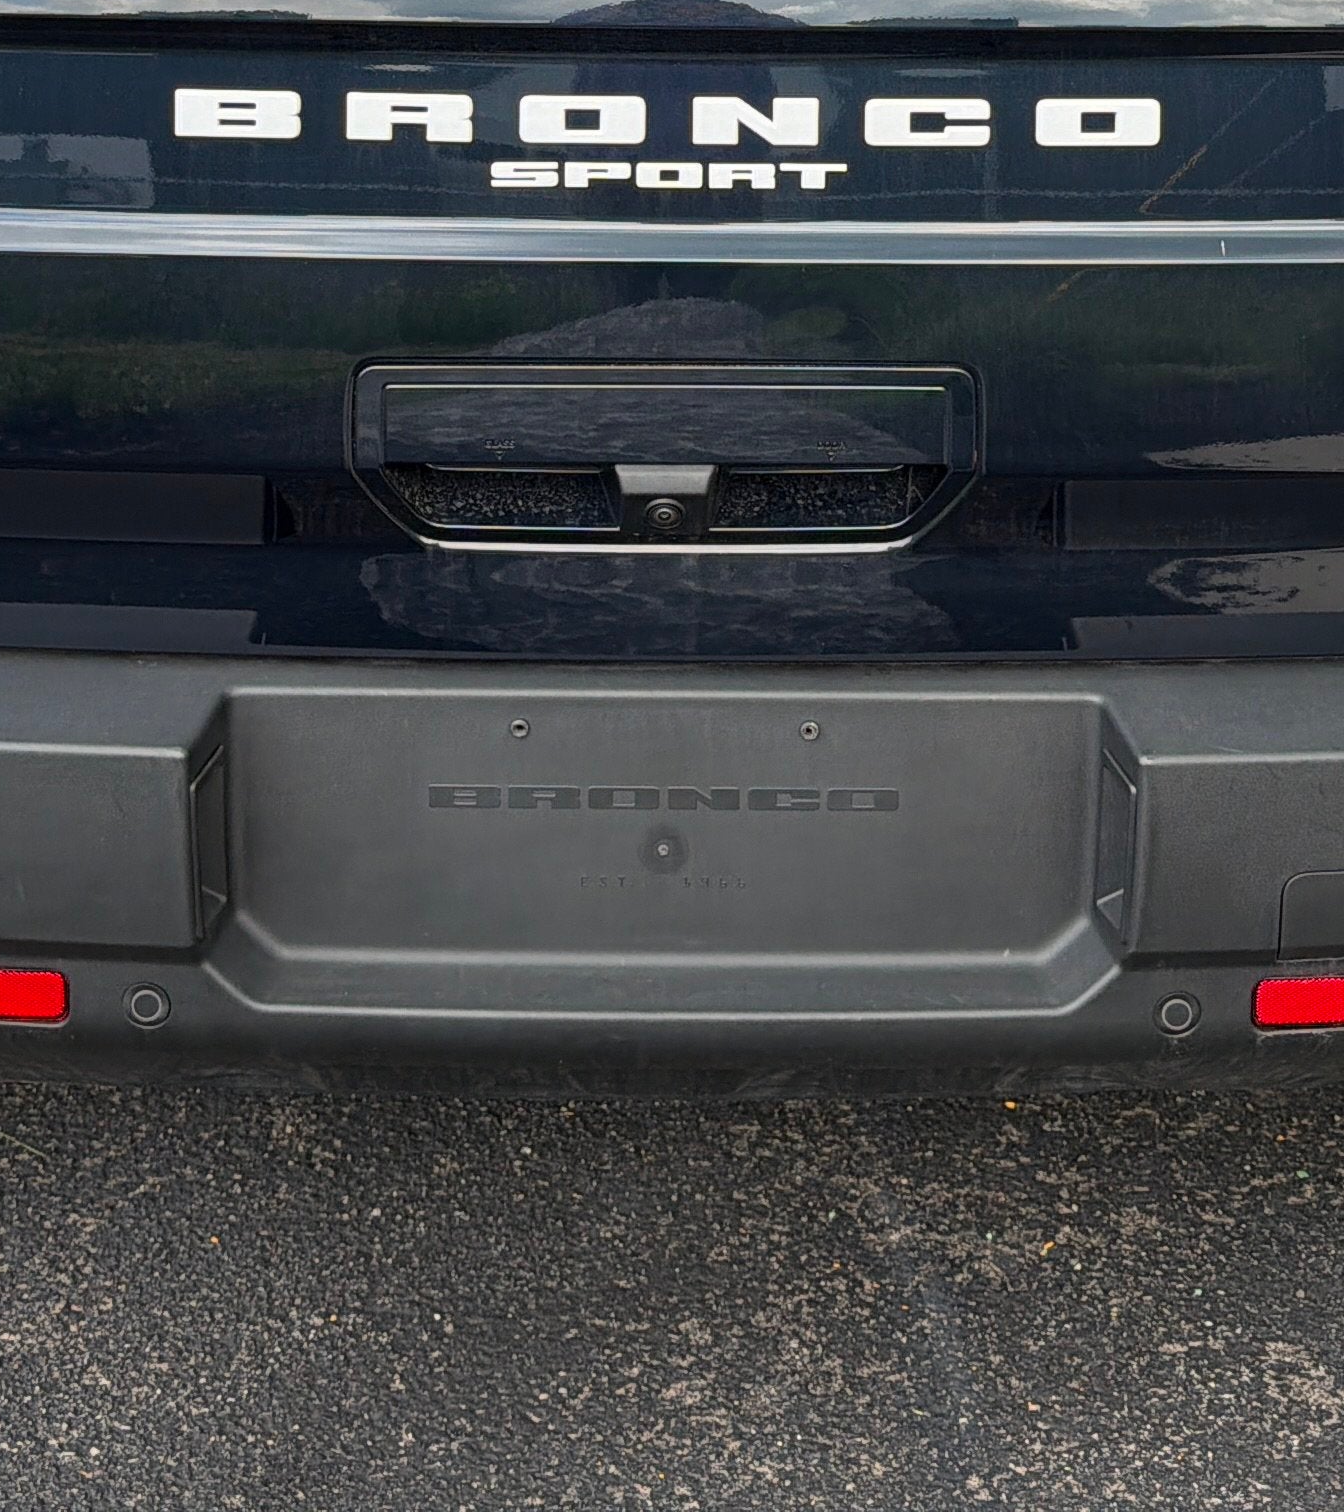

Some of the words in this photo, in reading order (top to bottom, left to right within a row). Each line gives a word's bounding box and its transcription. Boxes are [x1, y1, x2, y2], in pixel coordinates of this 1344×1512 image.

[174, 88, 1161, 147] BRONCO
[490, 161, 848, 190] SPORT
[428, 783, 900, 811] BRONCO
